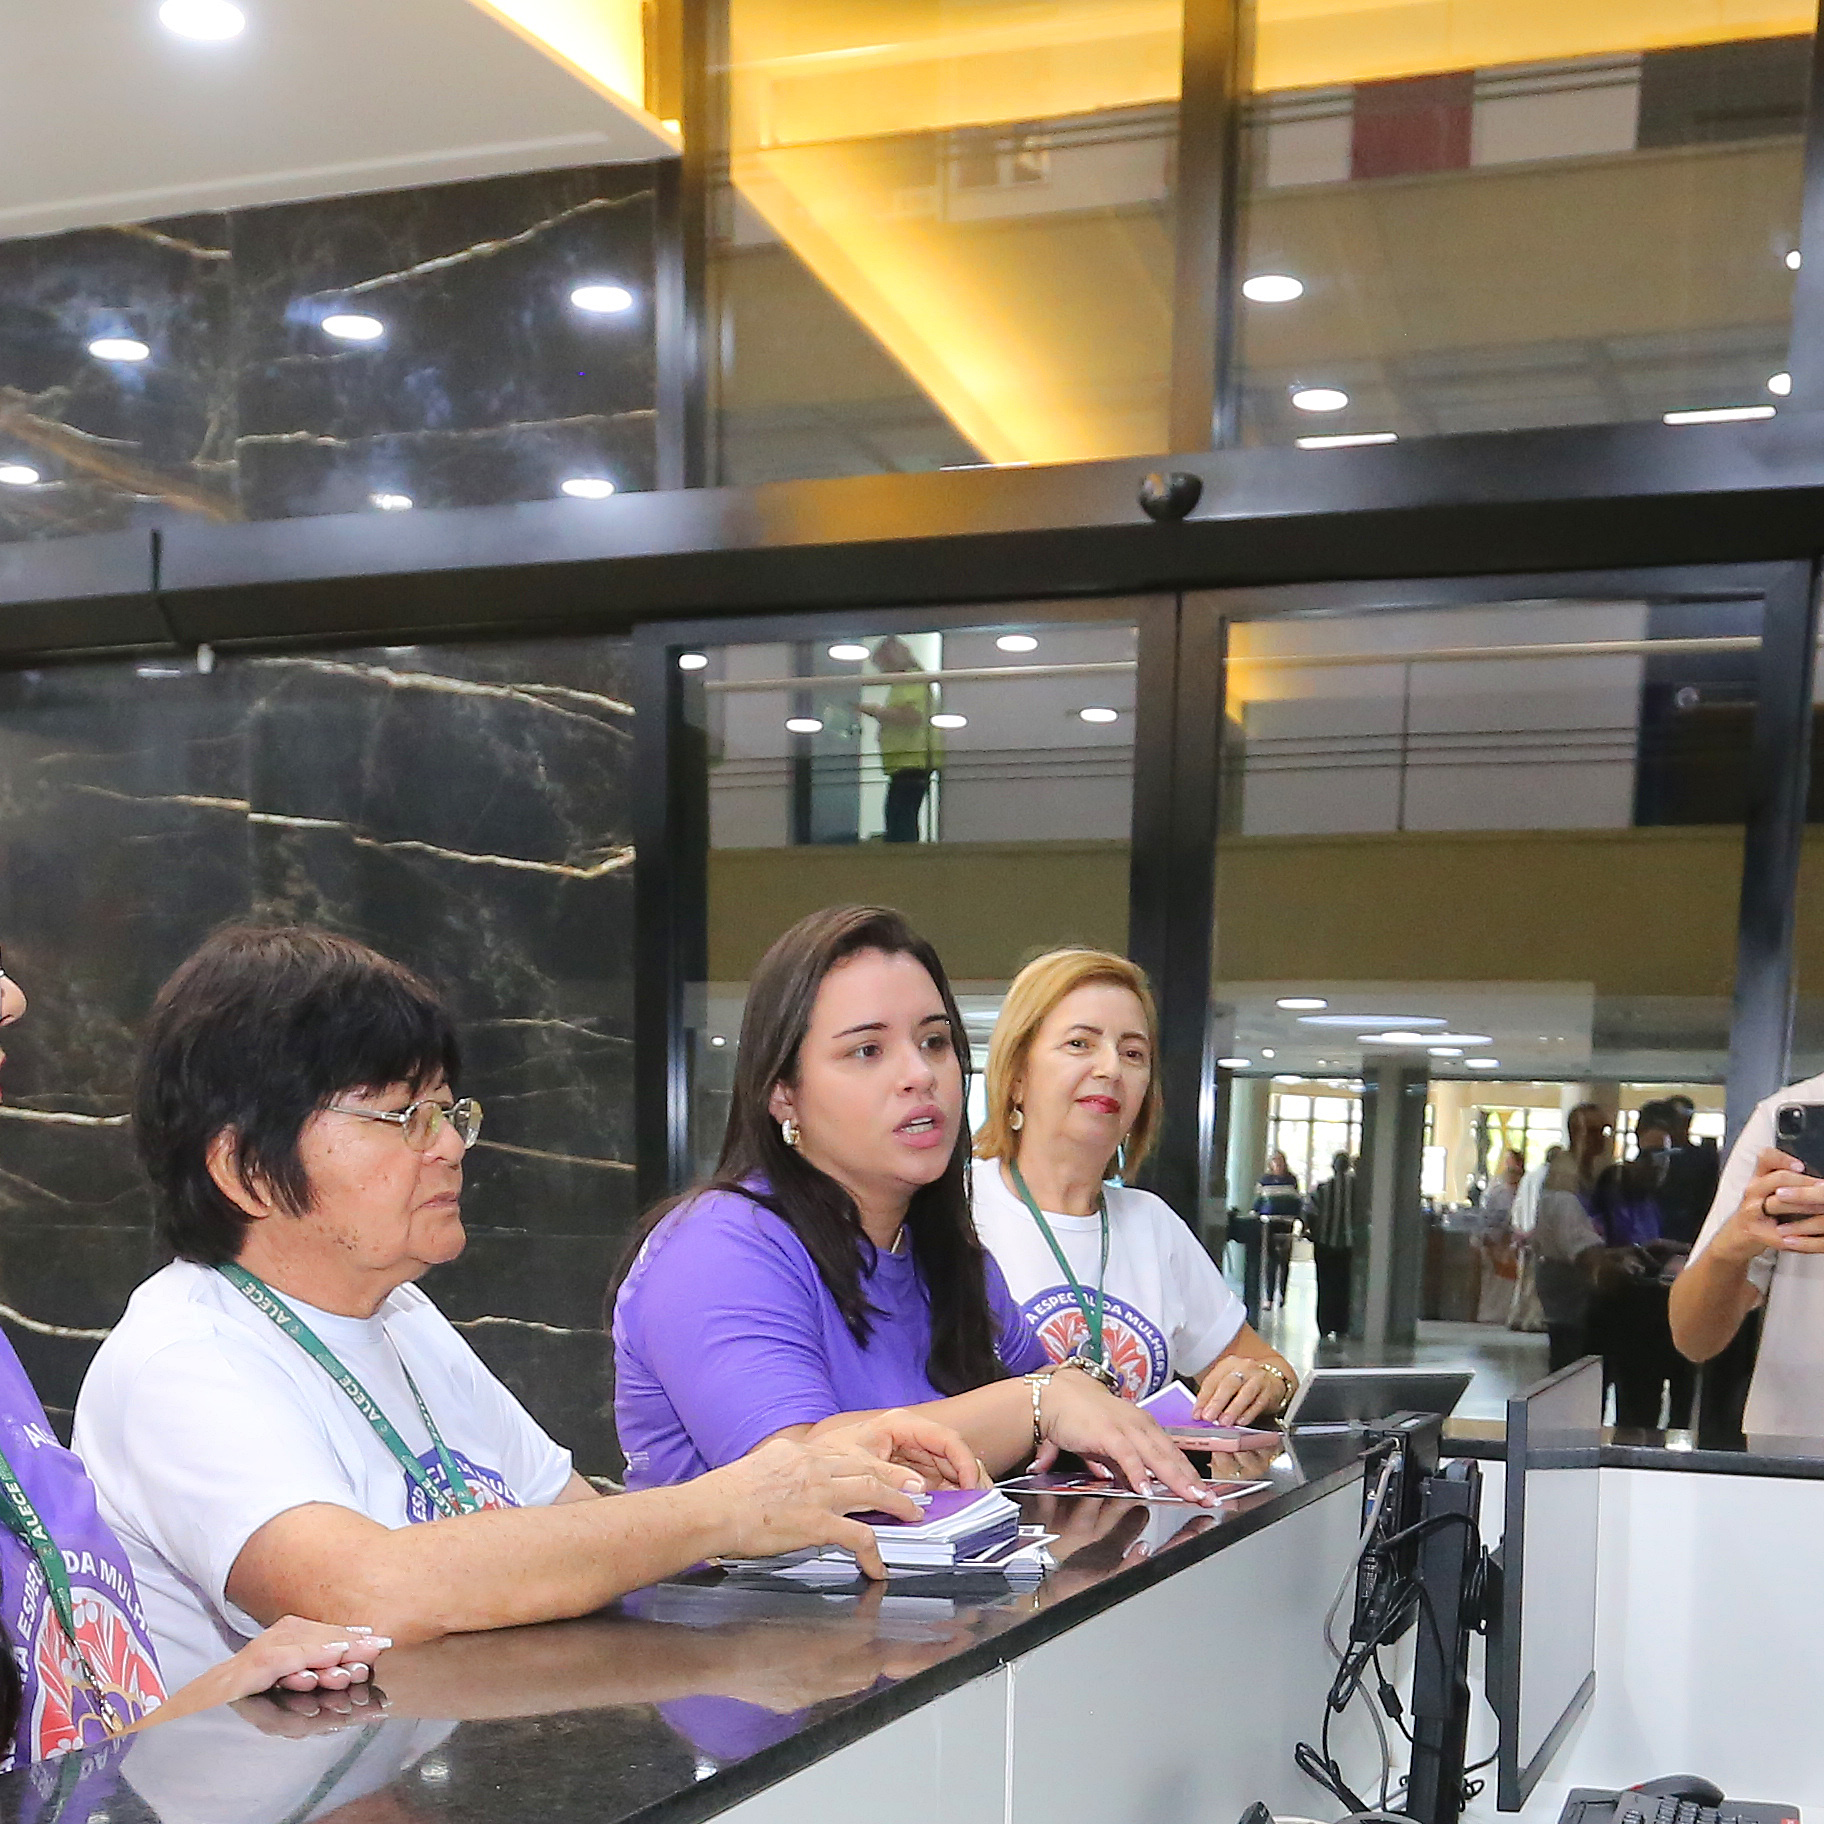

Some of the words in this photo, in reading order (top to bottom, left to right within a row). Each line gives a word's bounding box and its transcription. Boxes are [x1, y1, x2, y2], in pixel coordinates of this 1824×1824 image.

[242, 1282, 292, 1325] ALECE
[1125, 1311, 1165, 1371] MULHER
[339, 1375, 381, 1422] ALECE
[4, 1481, 48, 1541] ALECE
[61, 1550, 97, 1576] DA
